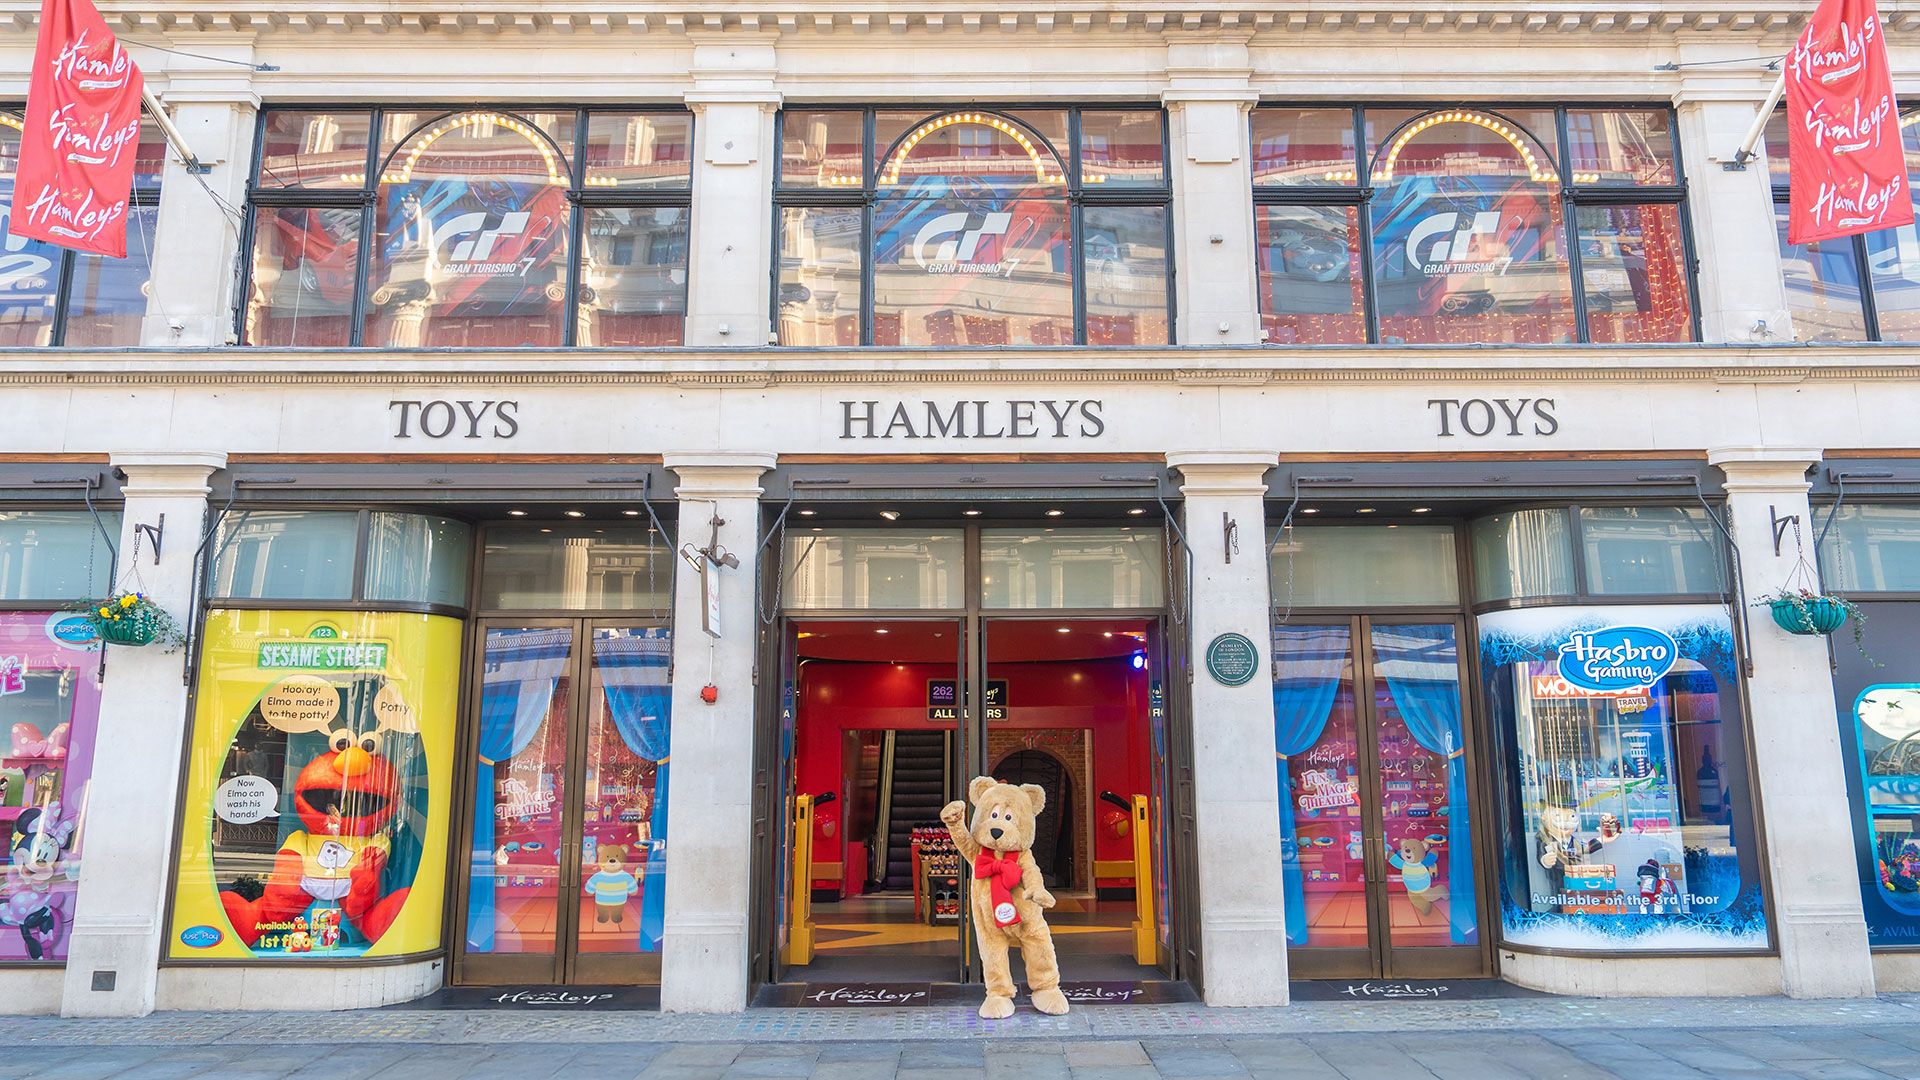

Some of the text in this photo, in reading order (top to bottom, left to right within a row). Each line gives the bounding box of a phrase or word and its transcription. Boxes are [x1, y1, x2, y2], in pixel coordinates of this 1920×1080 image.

[1809, 170, 1900, 226] Hamleys
[26, 173, 124, 242] Hamleys
[443, 257, 536, 277] GRAN TURISMO 7
[928, 258, 1020, 277] GRAN TURISMO 7
[1423, 257, 1513, 276] GRAN TURISMO 7
[389, 401, 519, 438] TOYS
[839, 400, 1106, 439] HAMLEYS
[1427, 398, 1559, 437] TOYS
[56, 623, 96, 634] Just Pla
[315, 628, 332, 637] 123
[260, 645, 386, 667] SESAME STREET
[1562, 635, 1667, 667] Hasbro
[1584, 658, 1654, 684] Gaming
[932, 686, 953, 696] 262
[267, 697, 334, 706] Elmo made it
[1617, 697, 1647, 706] TRAVEL
[281, 710, 298, 719] the
[299, 710, 330, 720] potty!
[934, 708, 1002, 719] ALL LRS
[1307, 747, 1345, 767] Hamleys
[507, 756, 547, 776] Hamleys
[237, 779, 256, 787] Now
[227, 789, 248, 797] Elmo
[226, 800, 261, 808] wash his
[229, 810, 258, 818] hands!
[1531, 893, 1720, 906] Available on the 3rd Floor
[254, 921, 296, 931] Available
[297, 923, 309, 931] on
[1883, 926, 1920, 937] AVAIL
[183, 932, 199, 940] Just
[260, 934, 317, 948] 1st floor
[806, 987, 926, 1002] Hamleys
[1340, 982, 1449, 996] Hamleys
[490, 990, 614, 1004] Hamleys
